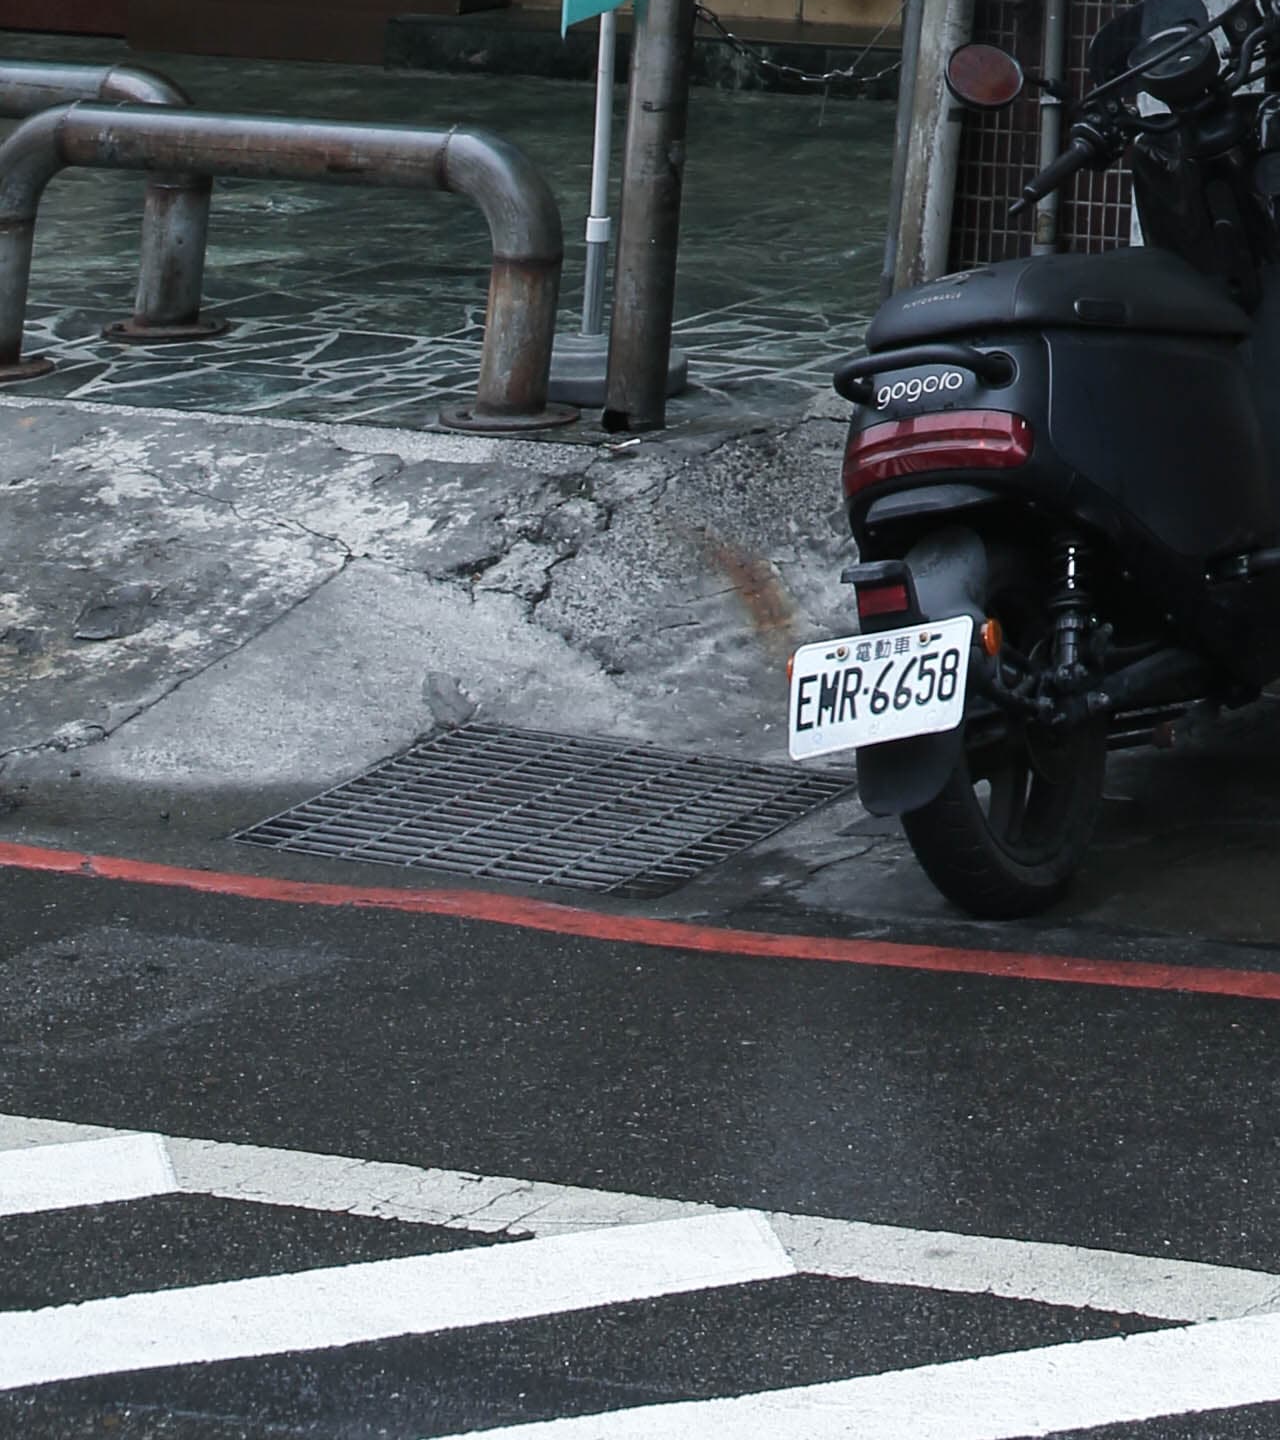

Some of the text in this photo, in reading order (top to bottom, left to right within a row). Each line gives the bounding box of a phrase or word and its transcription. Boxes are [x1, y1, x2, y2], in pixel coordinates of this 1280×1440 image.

[877, 371, 963, 410] gogoro
[855, 635, 912, 662] 電動車
